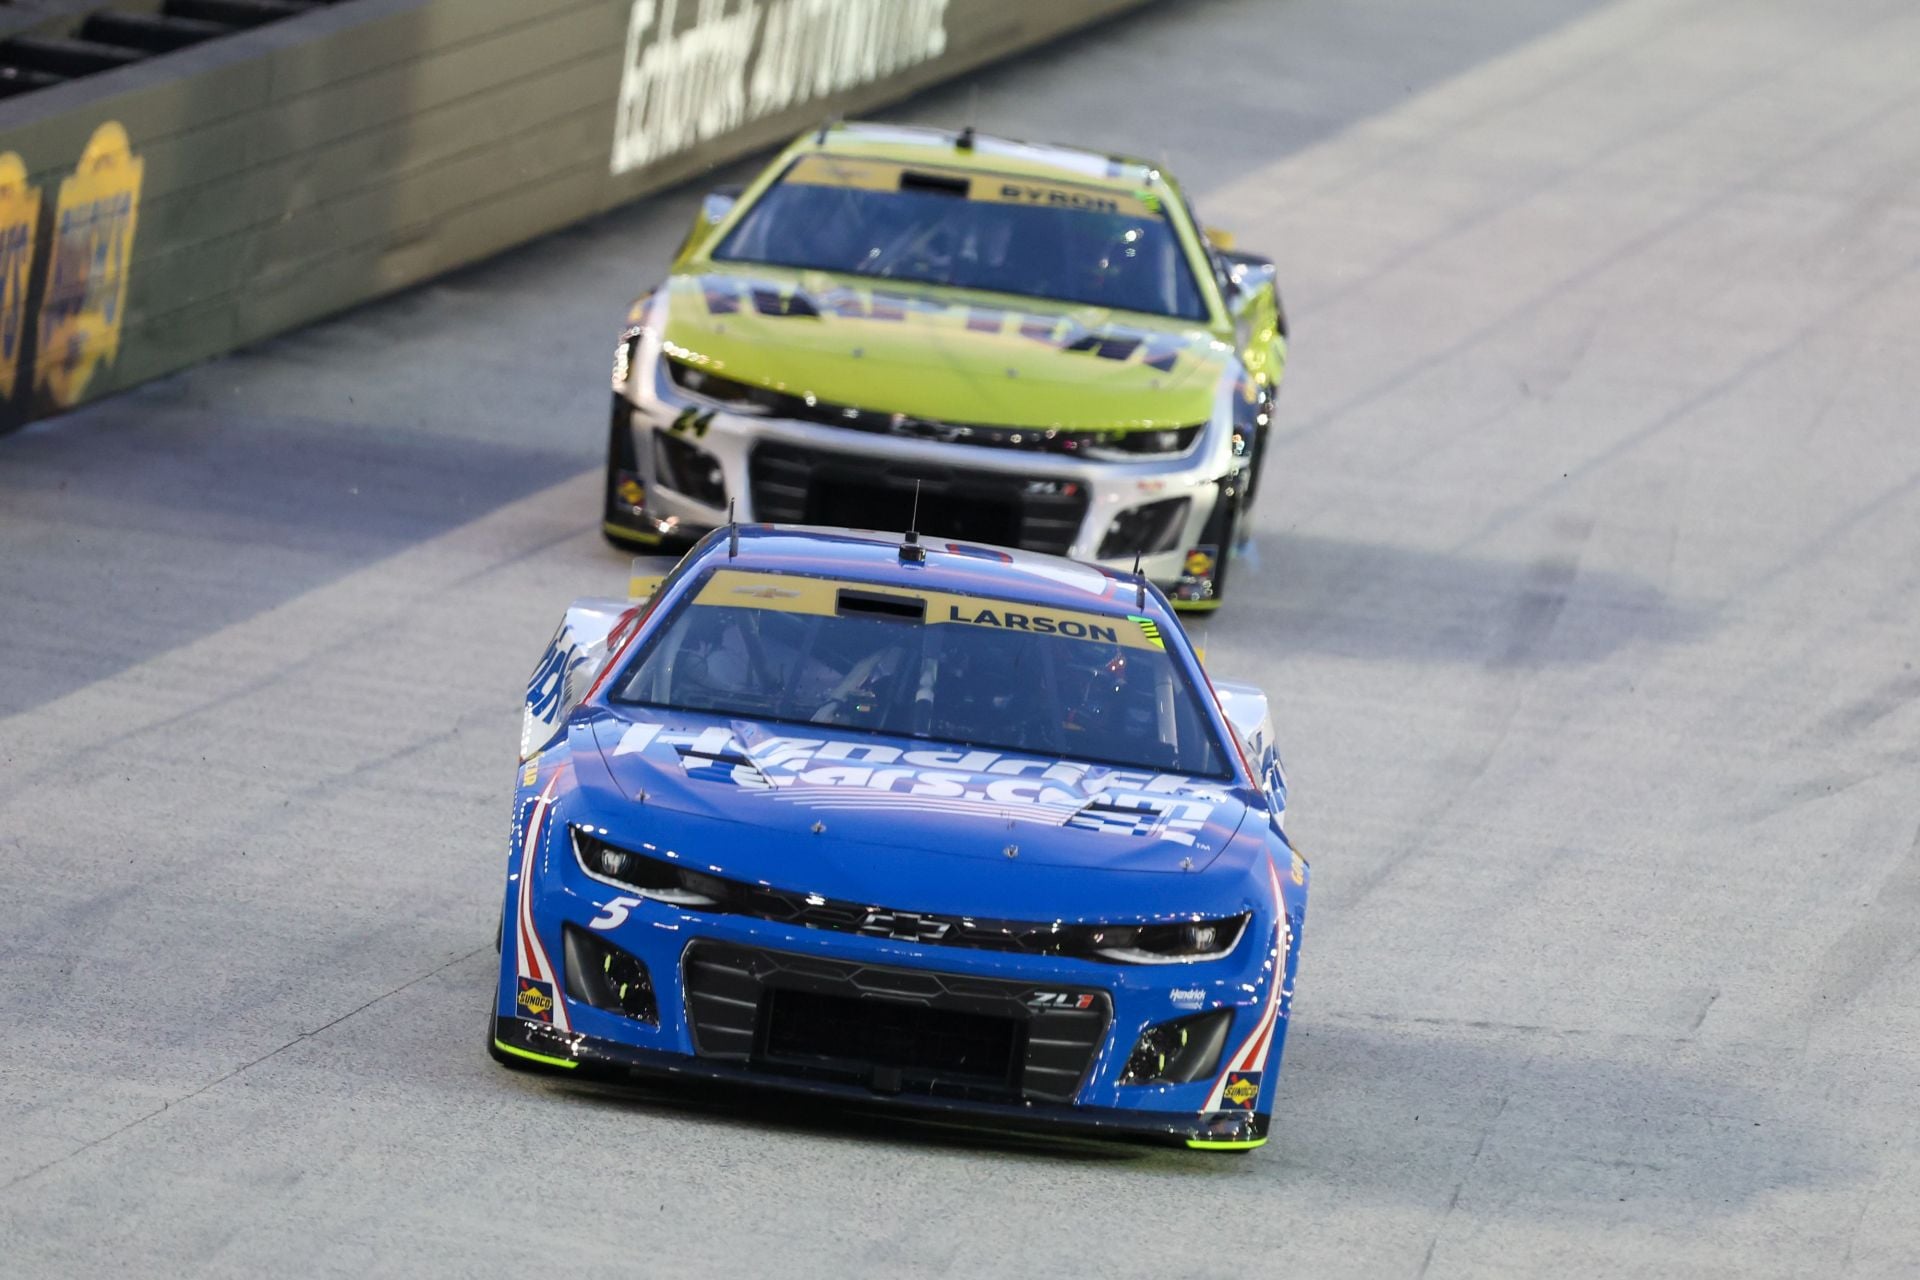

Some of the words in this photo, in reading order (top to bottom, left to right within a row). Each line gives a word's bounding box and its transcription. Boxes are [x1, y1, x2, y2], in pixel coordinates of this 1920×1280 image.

[1000, 184, 1118, 212] BYRON
[950, 605, 1118, 643] LARSON
[588, 896, 642, 930] 5
[518, 991, 552, 1009] SUNOCO
[1026, 992, 1095, 1009] ZL1
[1224, 1086, 1258, 1098] SUNOCO
